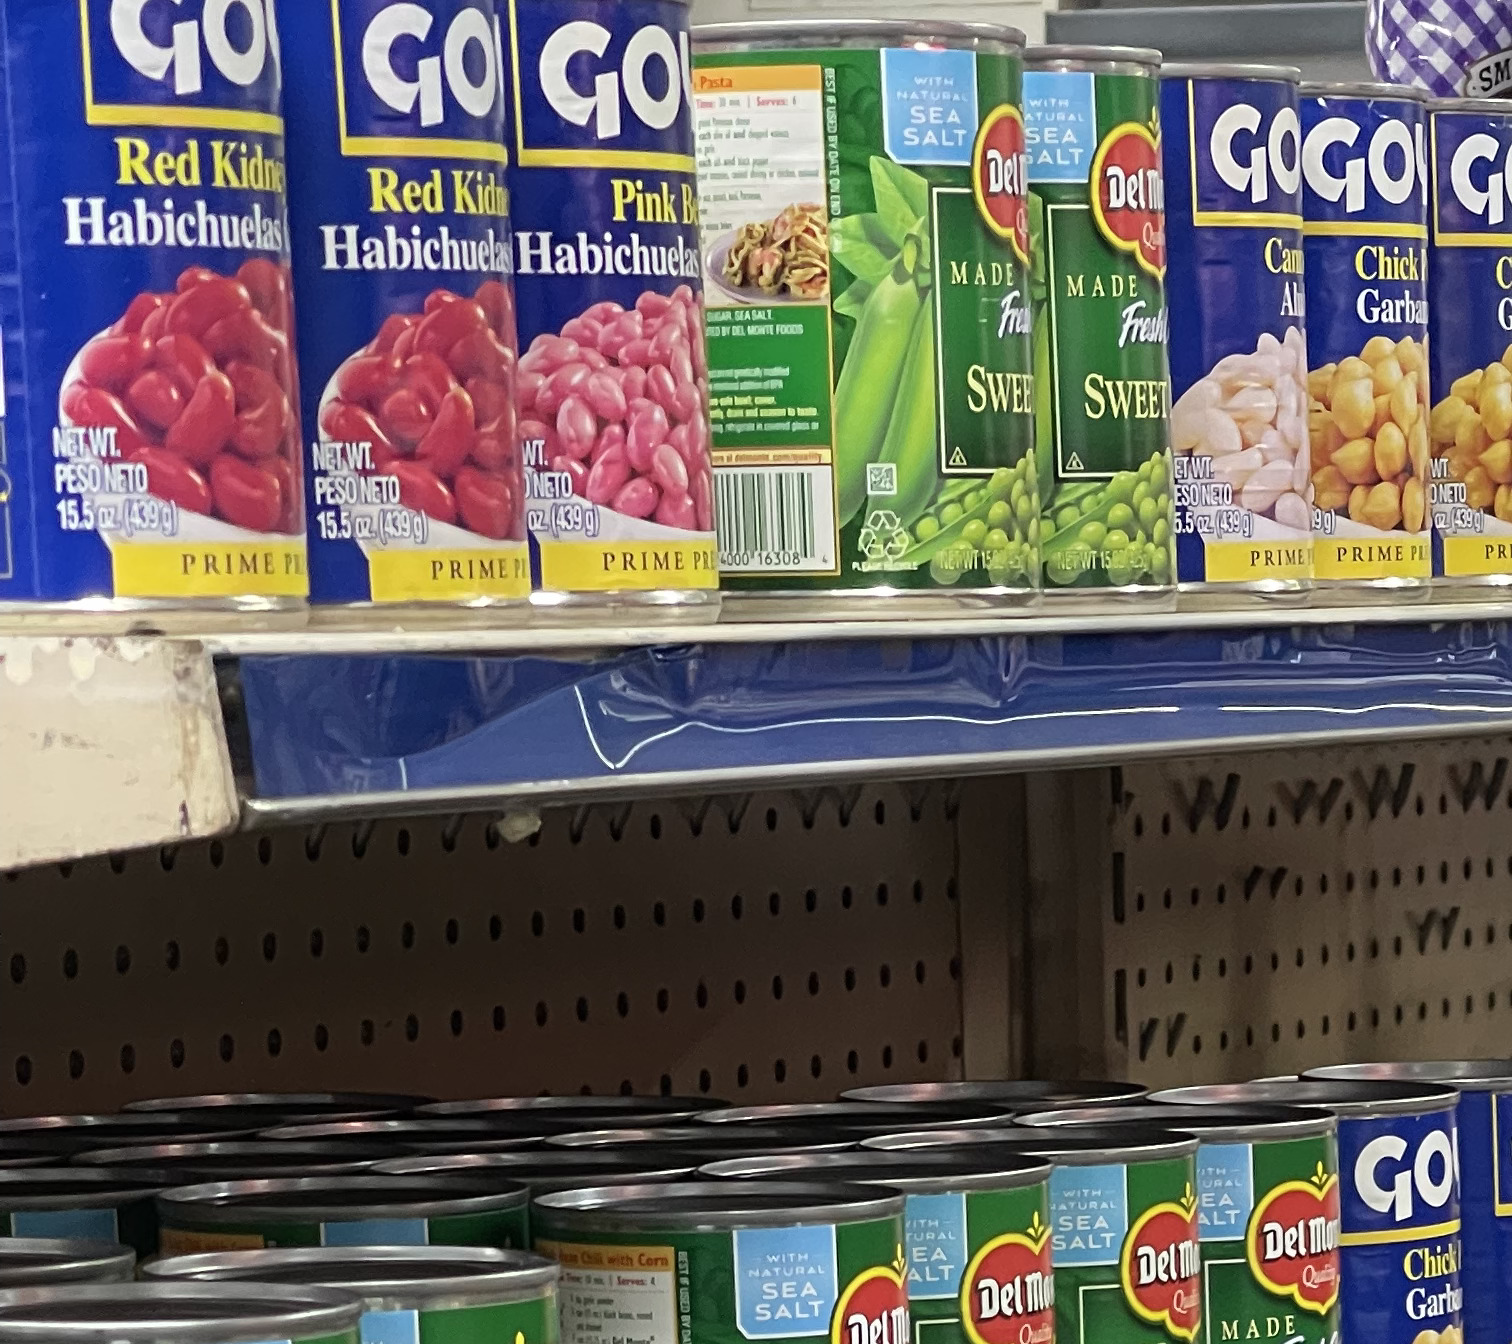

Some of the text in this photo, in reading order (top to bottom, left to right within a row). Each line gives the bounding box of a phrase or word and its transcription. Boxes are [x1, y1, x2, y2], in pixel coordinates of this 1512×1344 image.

[109, 0, 281, 95] GO
[361, 5, 500, 128] GO
[539, 20, 690, 139] GO
[914, 76, 954, 88] WITH
[910, 106, 960, 125] SEA
[903, 127, 967, 148] SALT
[1027, 127, 1077, 144] SEA
[117, 138, 200, 188] Red
[370, 168, 441, 213] Red
[1105, 165, 1145, 211] Del
[612, 179, 675, 223] Pink
[64, 197, 282, 250] Habichuelas
[320, 225, 511, 274] Habichuelas
[517, 231, 698, 278] Habichuelas
[950, 261, 1014, 286] MADE
[1355, 245, 1418, 282] Chick
[1067, 275, 1137, 298] MADE
[53, 428, 86, 458] NET
[313, 441, 343, 470] NET
[56, 464, 147, 493] PESO NETO
[314, 476, 399, 505] PESO NETO
[56, 500, 95, 530] 15.5
[317, 511, 353, 541] 15.5
[181, 550, 275, 576] PRIME
[602, 550, 684, 573] PRIME
[758, 551, 802, 567] 16308
[1250, 550, 1306, 567] PRIME
[1337, 545, 1404, 562] PRIME
[431, 557, 509, 581] PRIME
[1059, 1213, 1108, 1233] SEA
[1053, 1231, 1115, 1251] SALT
[607, 1253, 634, 1266] with
[638, 1253, 669, 1267] Corn
[767, 1253, 809, 1264] WITH
[1403, 1248, 1457, 1282] Chick
[749, 1265, 825, 1278] NATURAL
[763, 1281, 817, 1301] SEA
[755, 1300, 825, 1322] SALT
[1222, 1316, 1295, 1340] MADE
